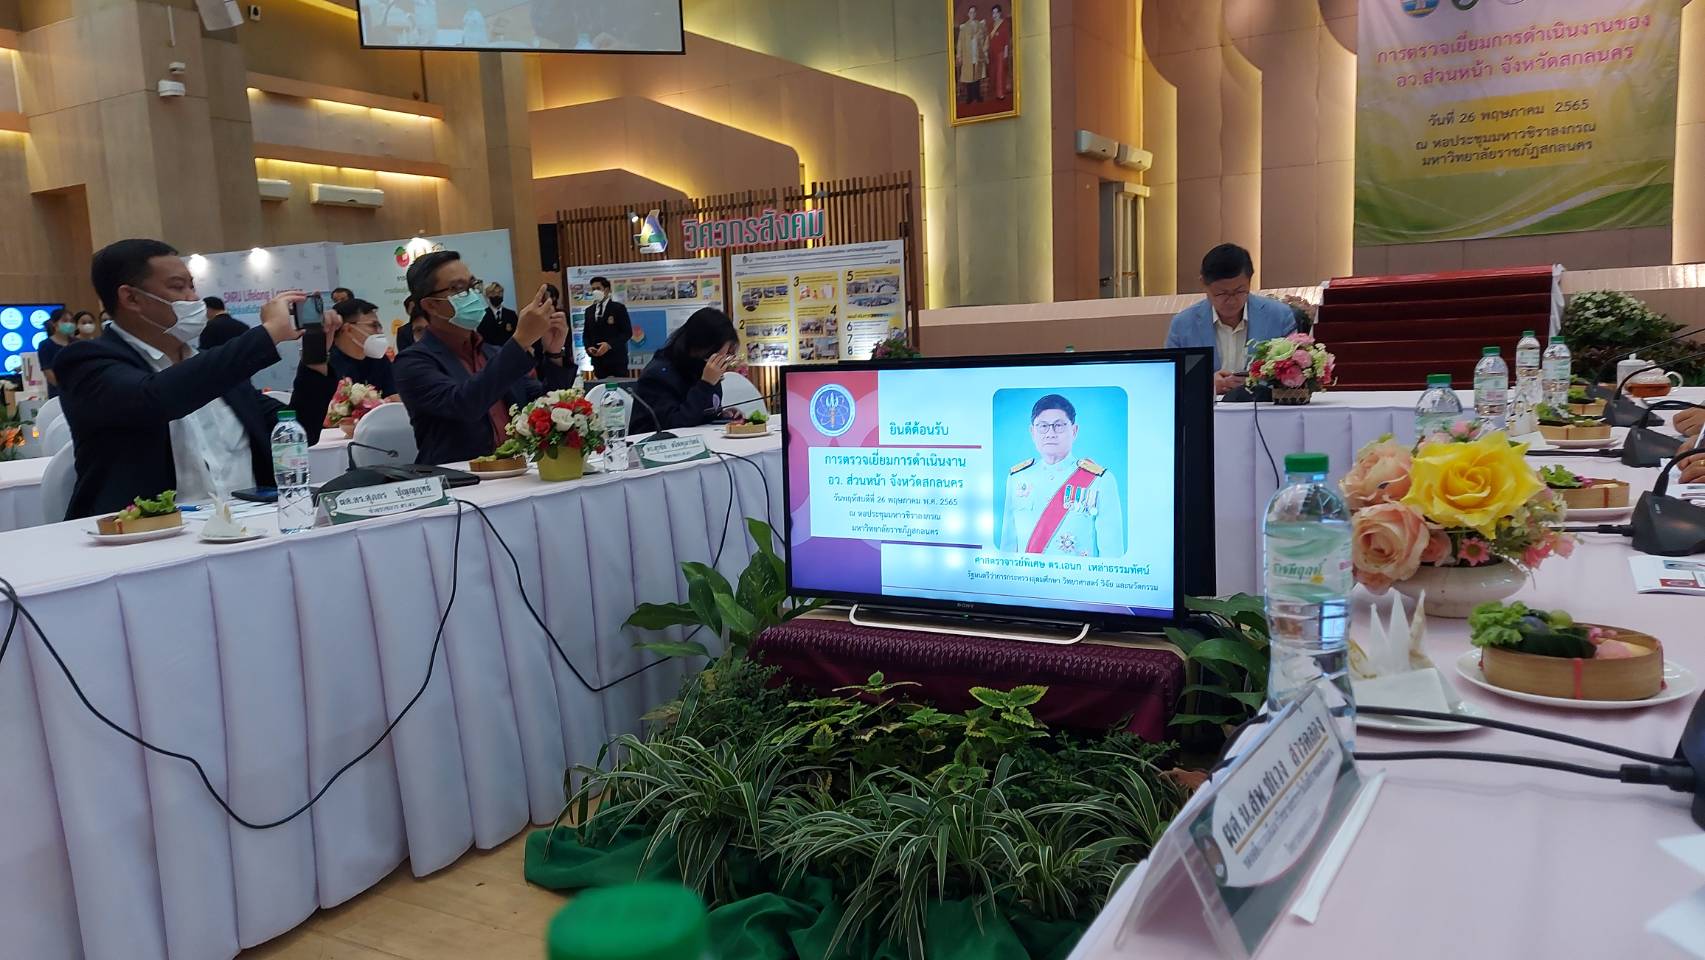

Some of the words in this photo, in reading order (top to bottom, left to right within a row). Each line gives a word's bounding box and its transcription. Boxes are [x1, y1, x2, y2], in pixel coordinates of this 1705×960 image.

[1376, 15, 1650, 63] การตรวจเยี่ยมการดำเนินงานของ
[1396, 59, 1493, 88] อว.ส่วนหน้า
[1501, 46, 1633, 74] จังหวัดสกลนคร
[1459, 111, 1475, 124] 26
[1481, 104, 1545, 122] พฤษภาคม
[1554, 99, 1590, 113] 2565
[683, 209, 825, 250] วิศวกรสังคม
[793, 276, 800, 287] 3
[847, 270, 854, 281] 5
[830, 304, 837, 316] 4
[739, 319, 745, 330] 2
[846, 321, 853, 331] 6
[847, 333, 853, 344] 7
[847, 345, 853, 356] 8
[889, 421, 949, 436] ยินดีต้อนรับ
[824, 449, 967, 468] การตรวจเยี่ยมการดำเนินงาน
[828, 475, 843, 485] อว.
[846, 473, 886, 487] ส่วนหน้า
[890, 473, 964, 489] จังหวัดสกลนคร
[877, 495, 886, 503] 26
[940, 498, 958, 506] 2565
